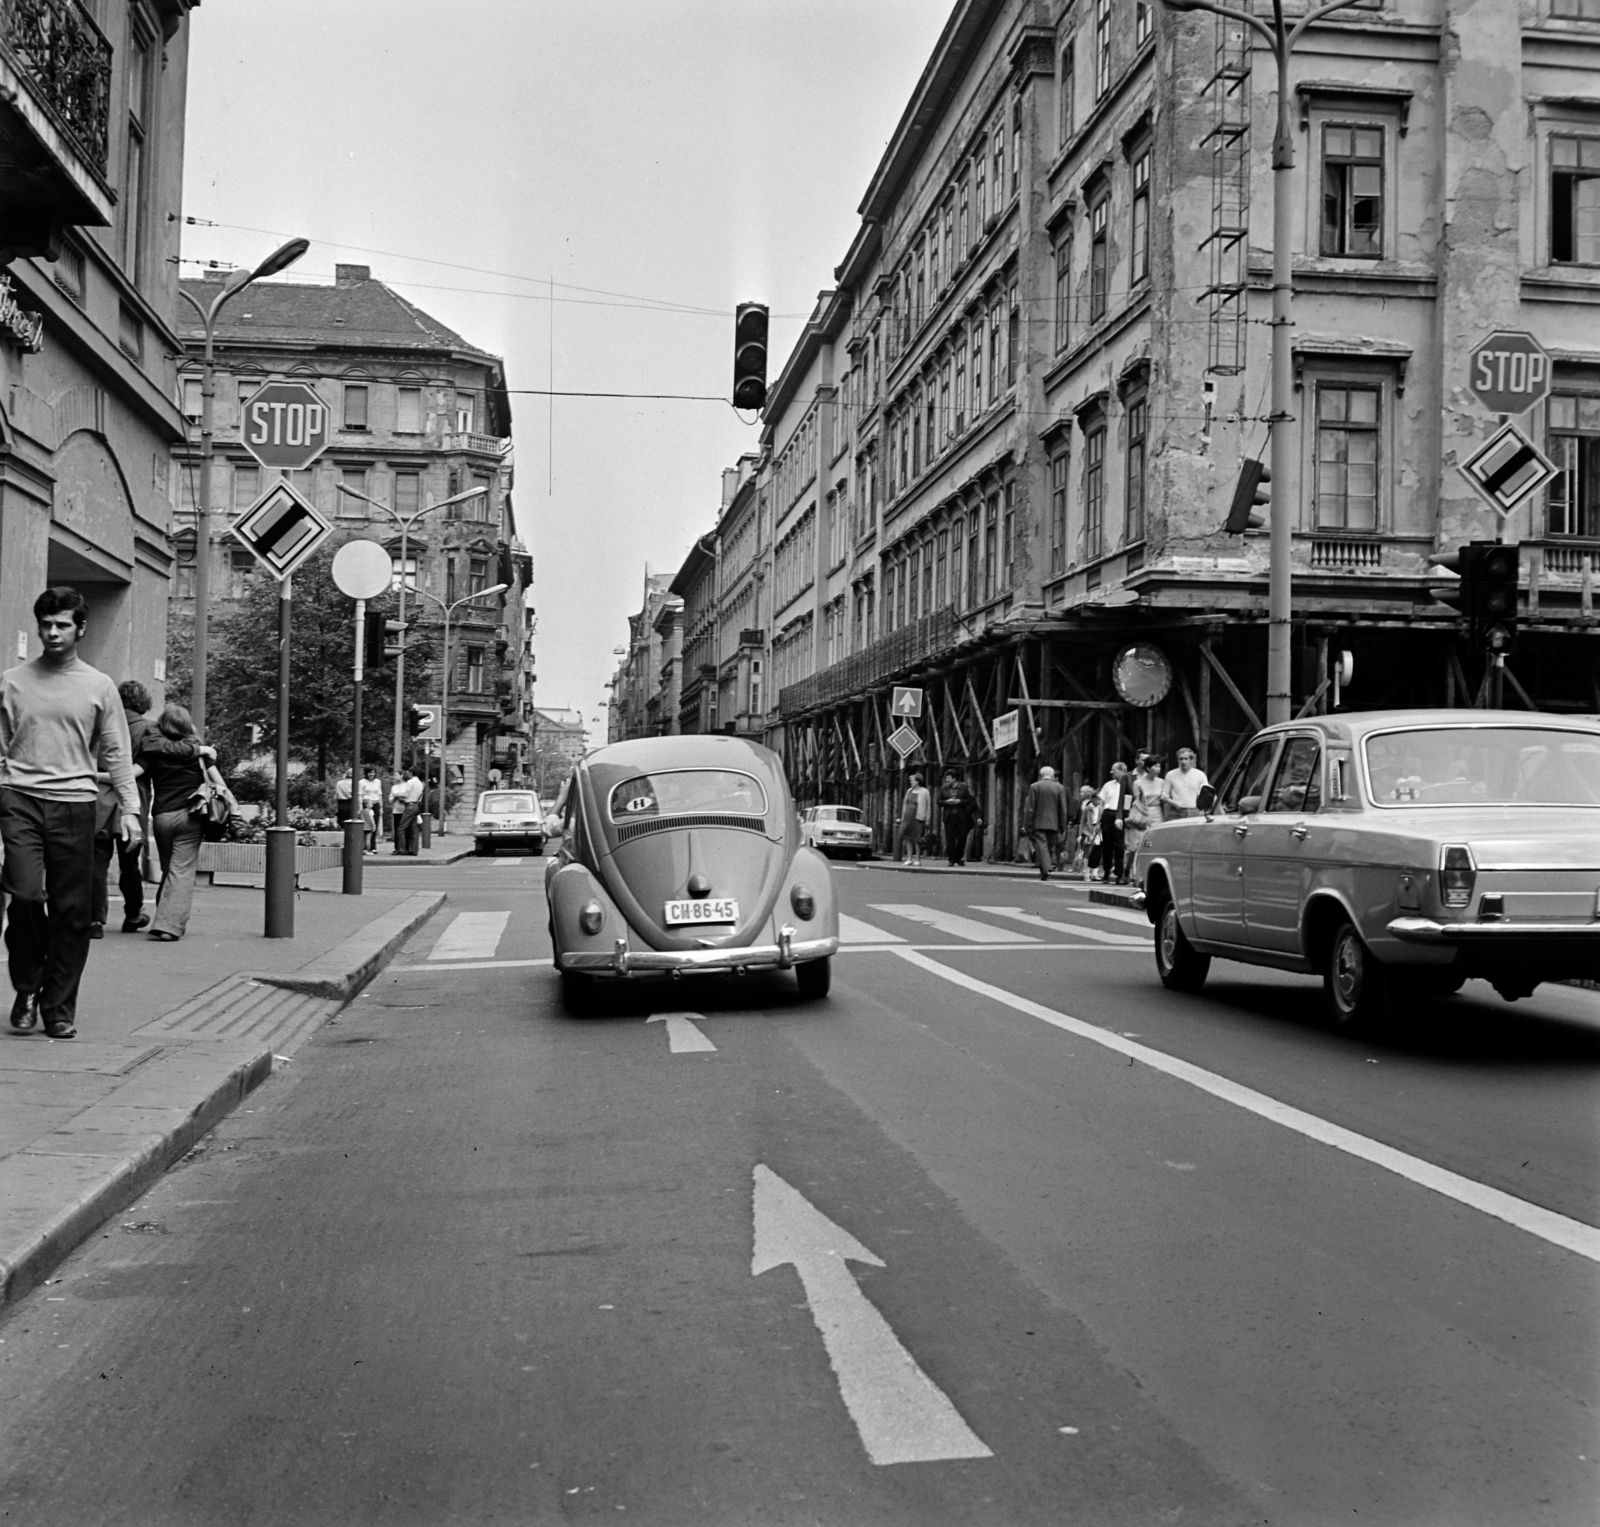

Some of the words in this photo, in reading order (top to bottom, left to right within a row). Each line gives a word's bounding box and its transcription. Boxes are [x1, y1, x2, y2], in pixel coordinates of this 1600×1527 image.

[1476, 351, 1544, 393] STOP
[251, 402, 322, 446] STOP
[633, 798, 645, 810] H
[1395, 788, 1415, 800] H
